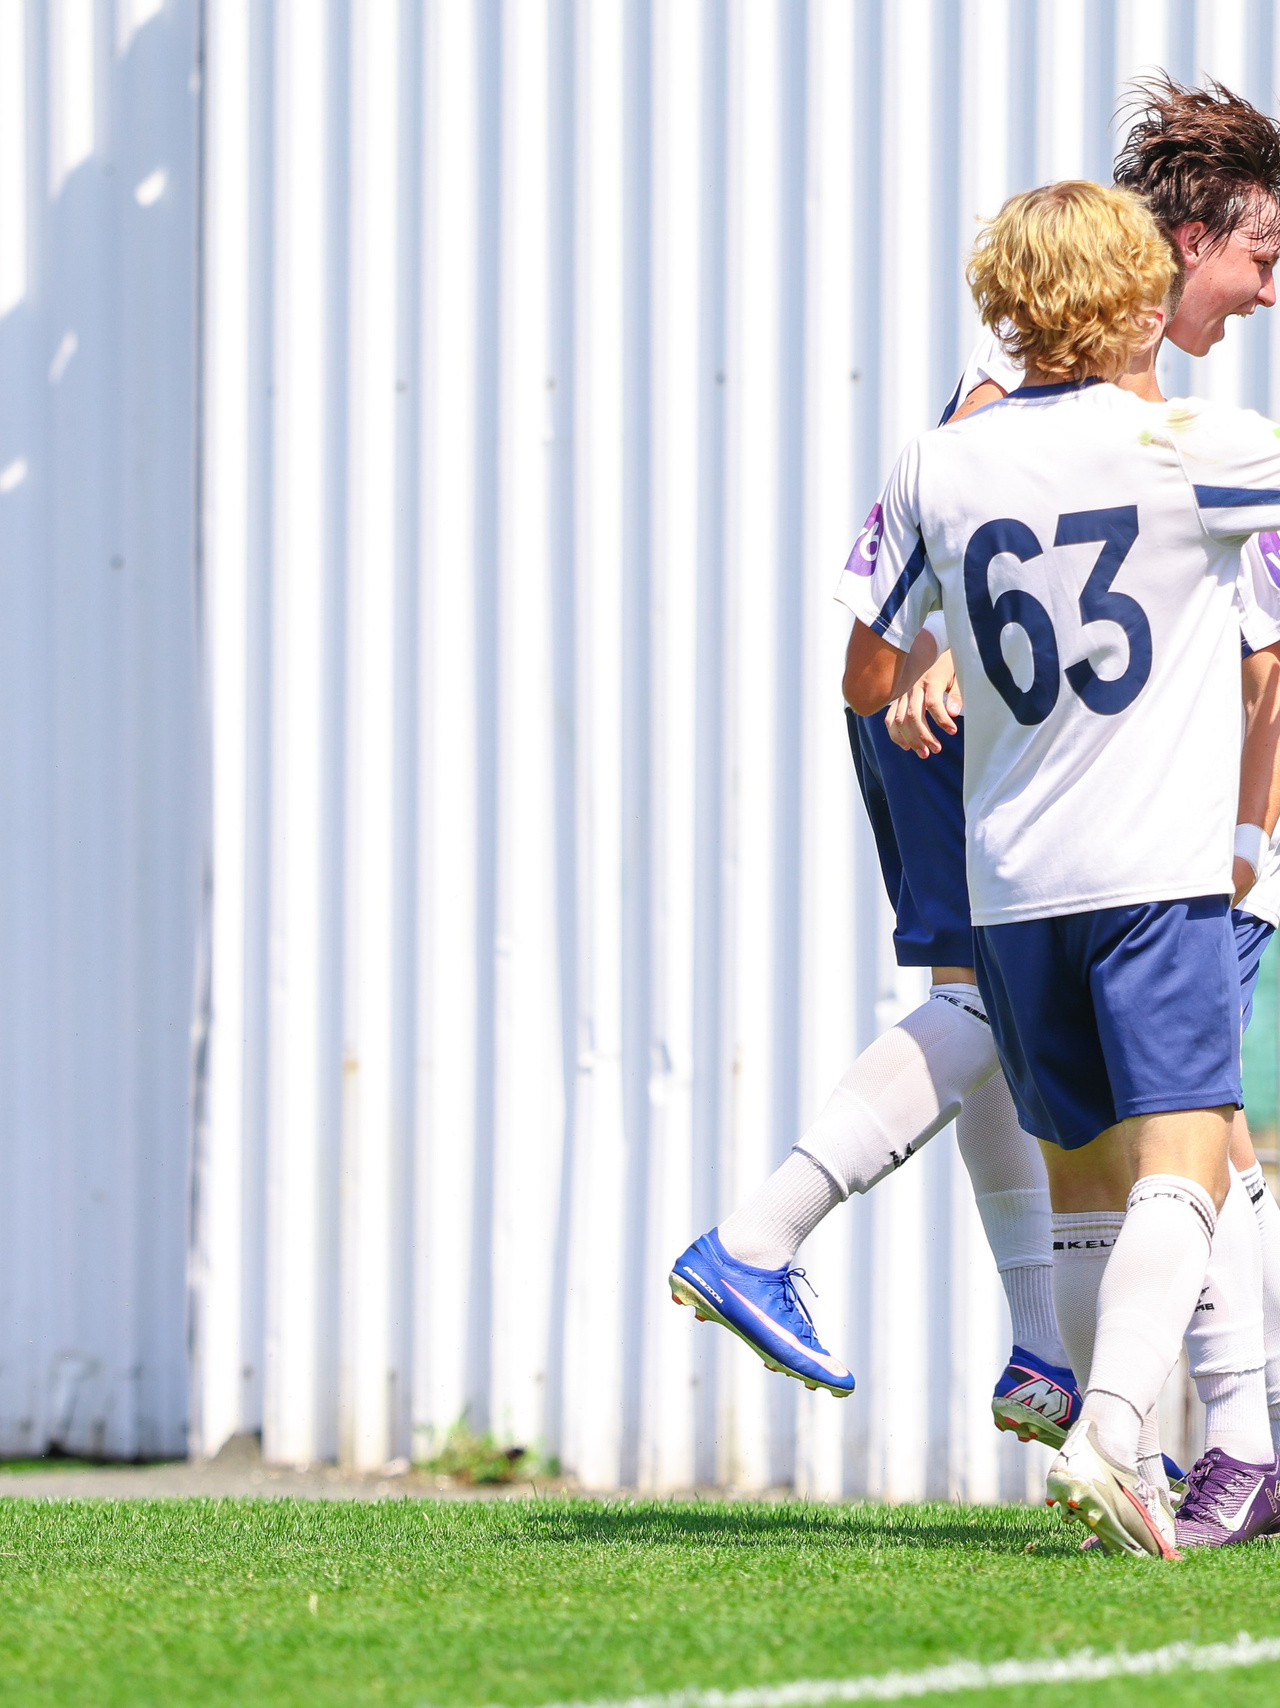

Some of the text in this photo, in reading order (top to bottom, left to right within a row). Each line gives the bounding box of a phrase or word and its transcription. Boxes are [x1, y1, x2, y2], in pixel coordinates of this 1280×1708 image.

[857, 521, 880, 562] b
[964, 505, 1153, 726] 63
[1067, 1238, 1116, 1250] KEL
